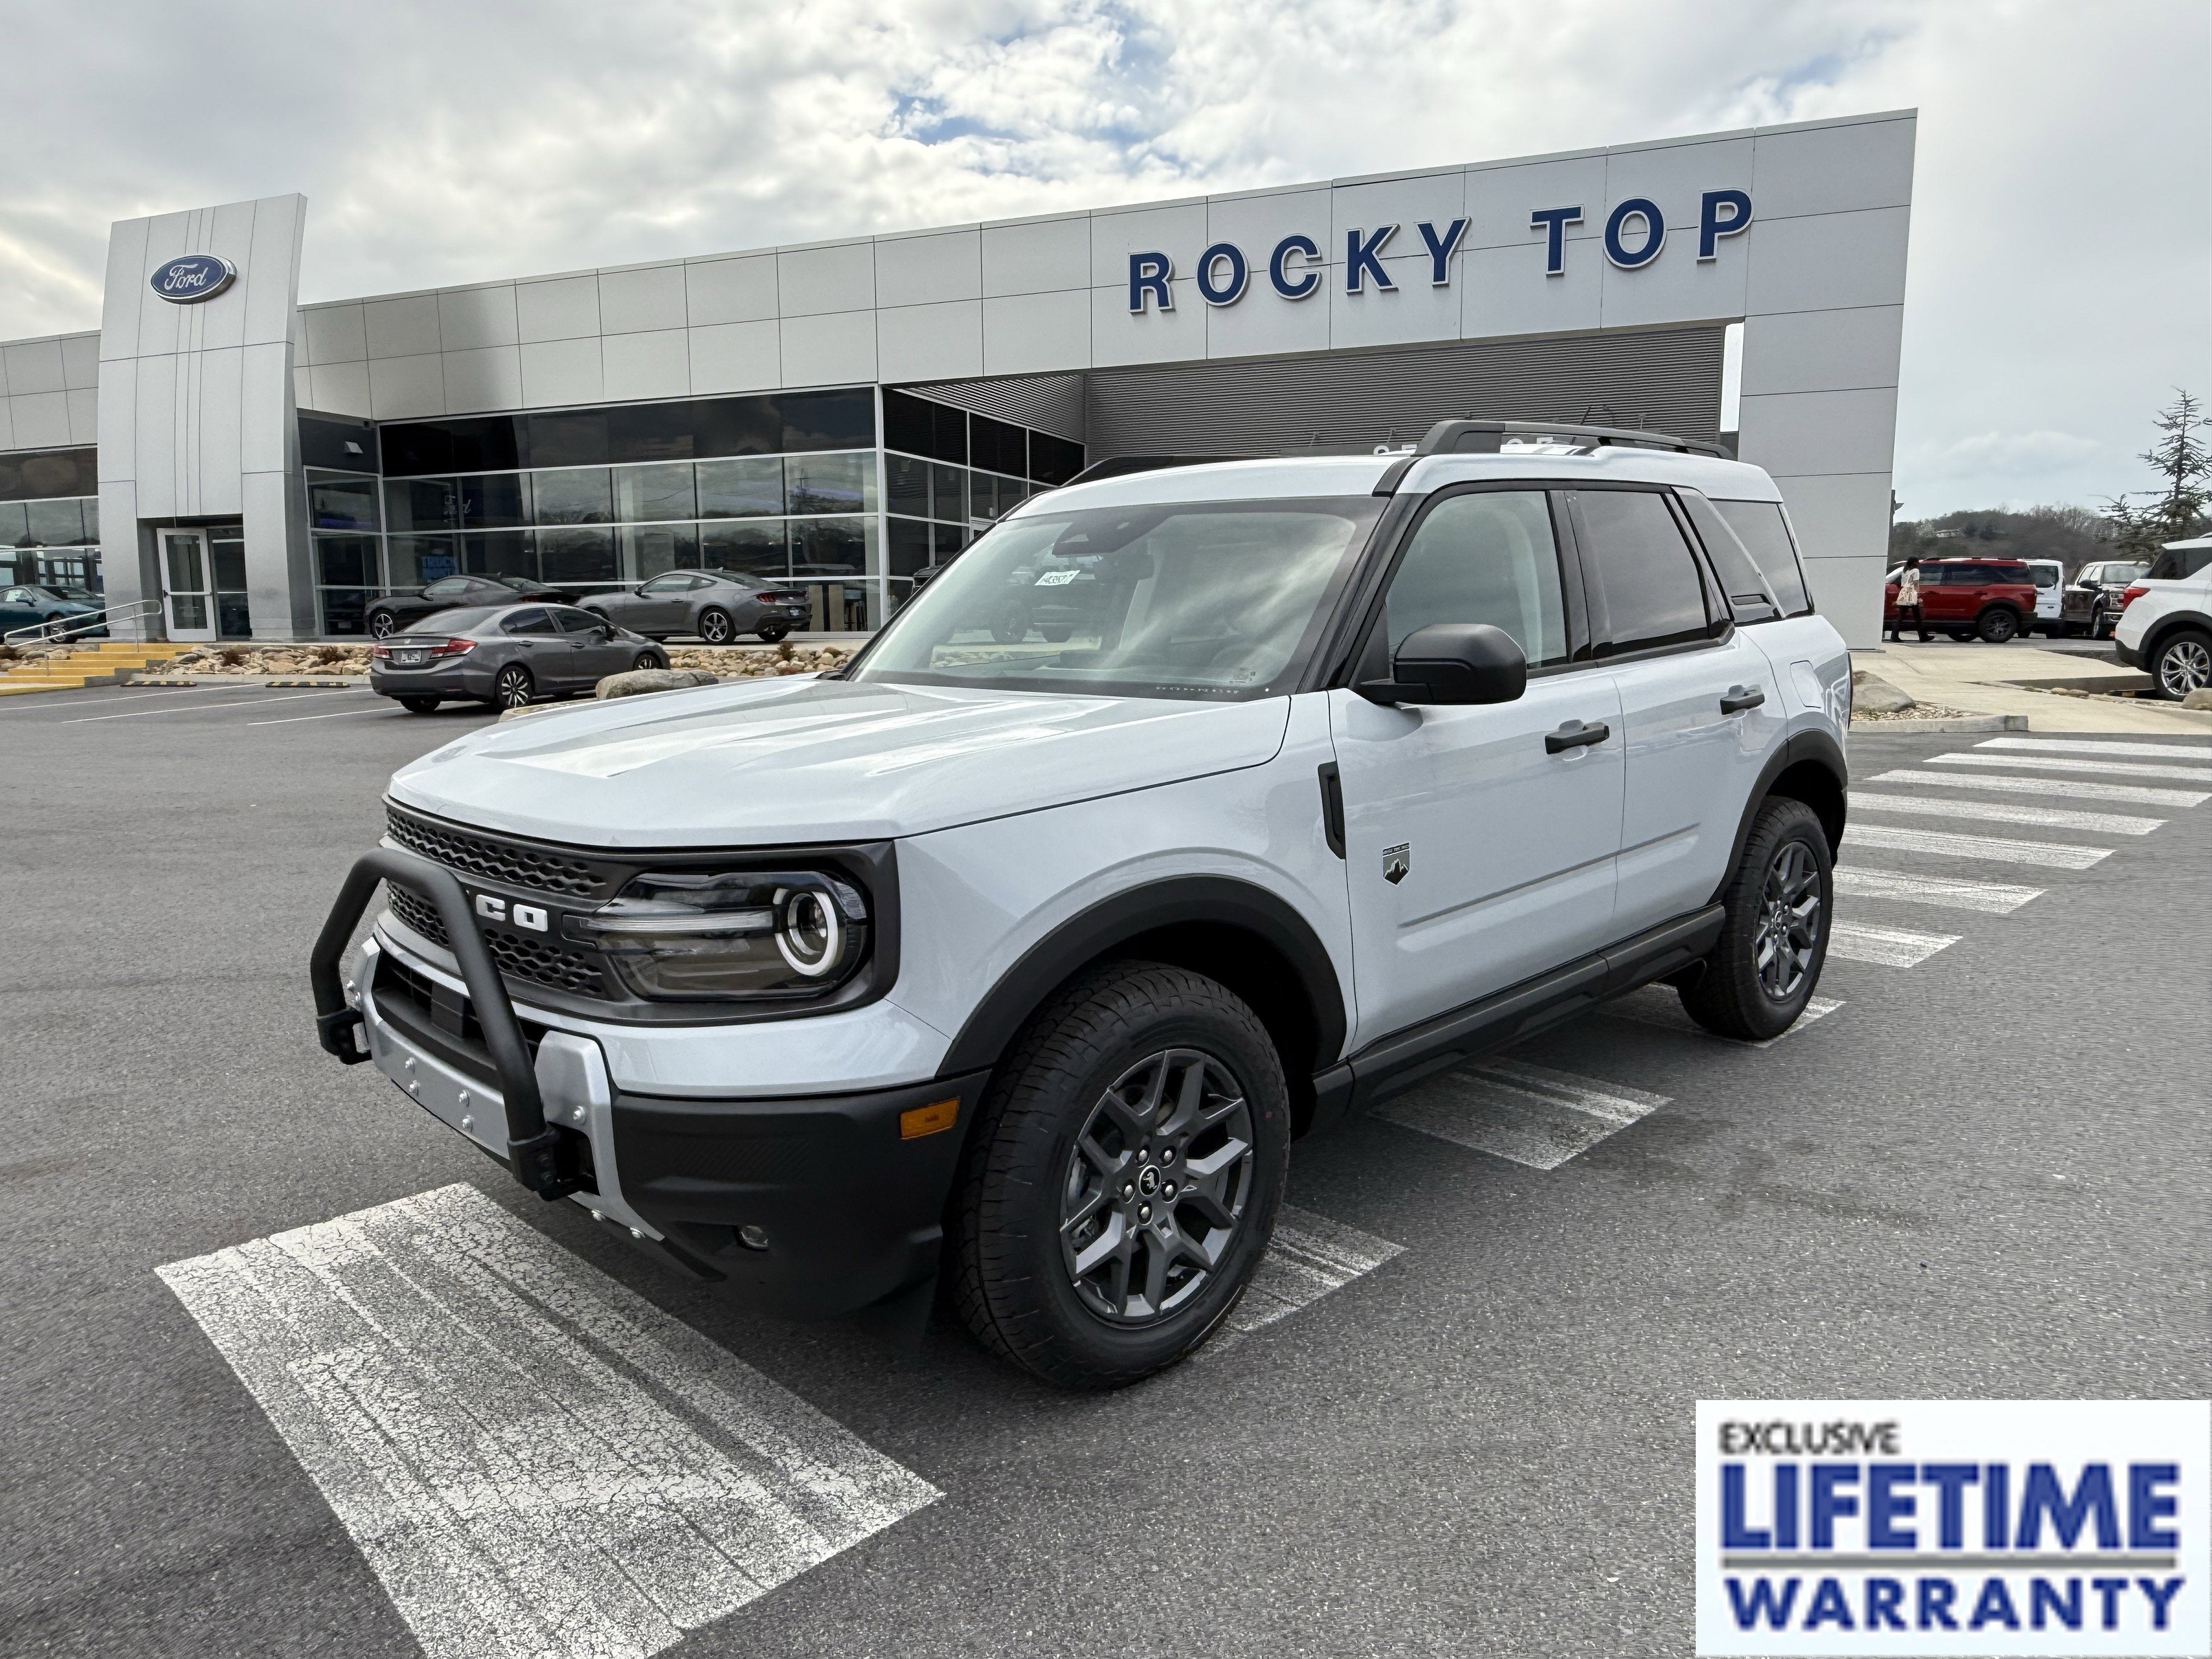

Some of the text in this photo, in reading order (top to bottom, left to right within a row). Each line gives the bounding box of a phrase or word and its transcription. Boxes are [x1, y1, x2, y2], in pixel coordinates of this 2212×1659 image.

[1128, 190, 1752, 312] ROCKY TOP
[164, 263, 208, 290] Ford
[475, 894, 549, 932] CO
